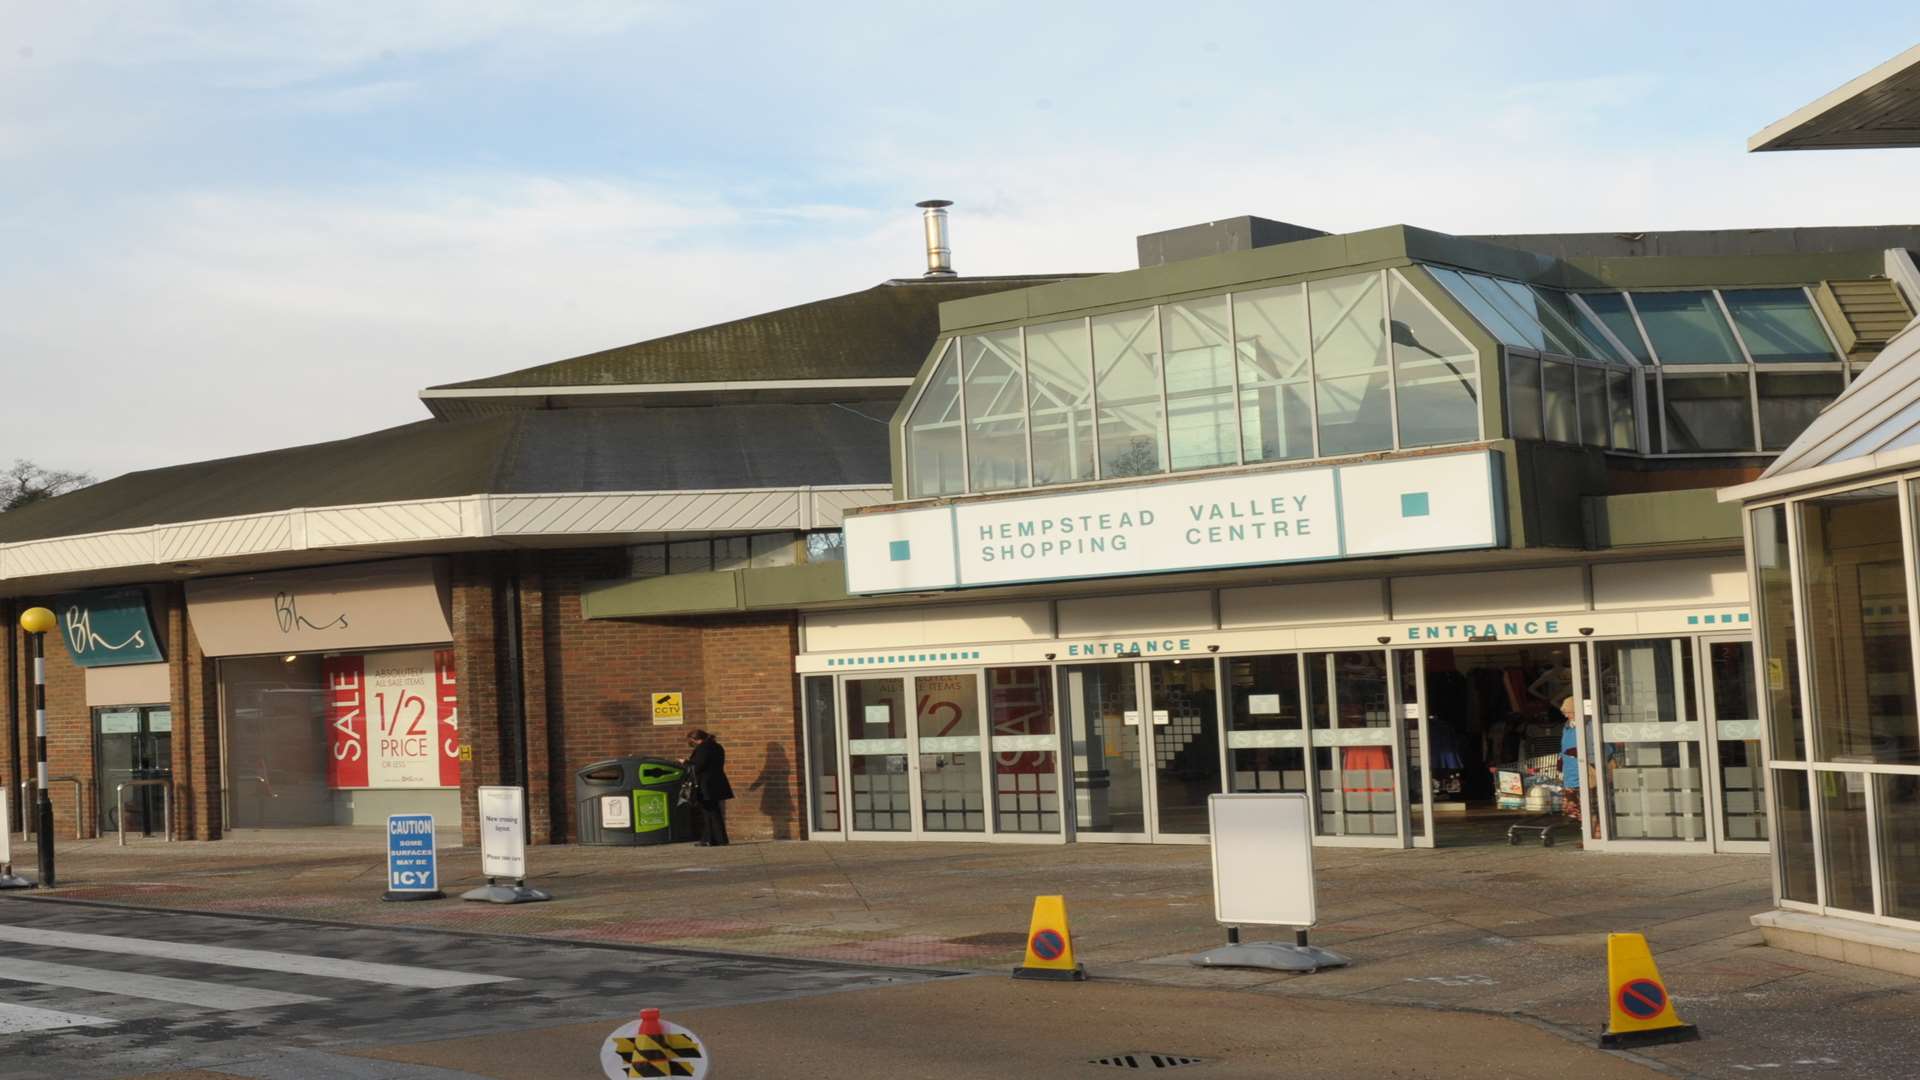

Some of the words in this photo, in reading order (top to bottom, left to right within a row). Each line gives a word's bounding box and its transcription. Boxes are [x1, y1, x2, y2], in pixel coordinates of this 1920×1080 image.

[979, 510, 1155, 540] HEMPSTEAD
[1189, 495, 1307, 521] VALLEY
[982, 535, 1128, 562] SHOPPING
[1186, 518, 1312, 545] CENTRE
[274, 591, 348, 633] Bhs
[66, 605, 144, 654] Bhs
[1408, 620, 1560, 640] ENTRANCE
[1068, 639, 1190, 656] ENTRANCE
[329, 670, 362, 762] SALE
[375, 689, 427, 736] 1/2
[380, 738, 428, 757] PRICE
[390, 820, 432, 834] CAUTION
[391, 849, 432, 857] SURFACES
[393, 871, 430, 885] ICY
